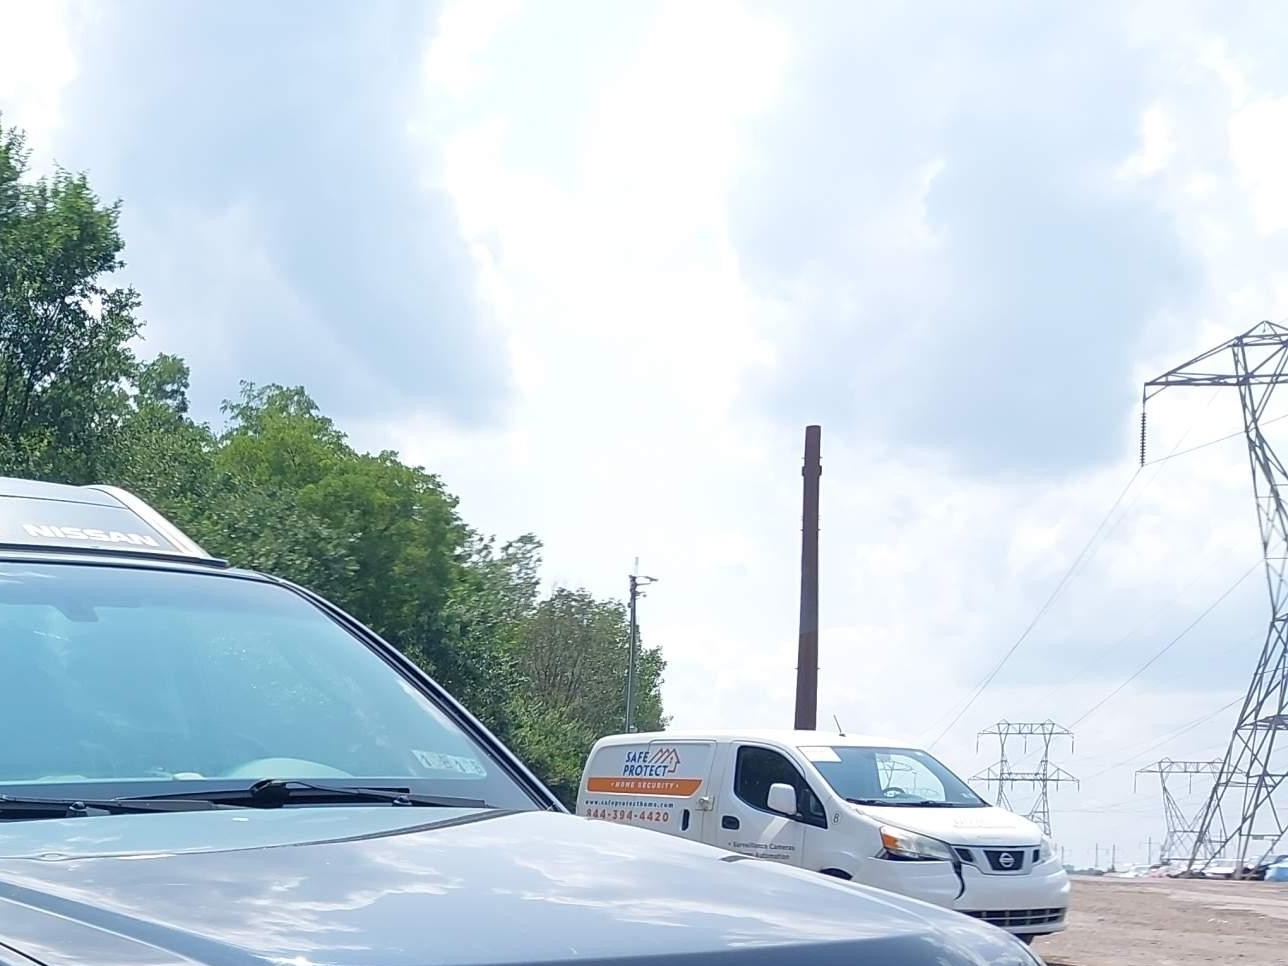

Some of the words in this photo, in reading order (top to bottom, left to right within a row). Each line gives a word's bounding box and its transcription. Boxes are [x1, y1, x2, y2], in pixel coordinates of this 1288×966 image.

[22, 524, 160, 546] NISSAN
[625, 751, 649, 763] SAFE
[623, 764, 669, 776] PROTECT
[615, 781, 634, 789] HOME
[638, 782, 675, 790] SECURITY
[585, 809, 669, 822] 844-394-4420
